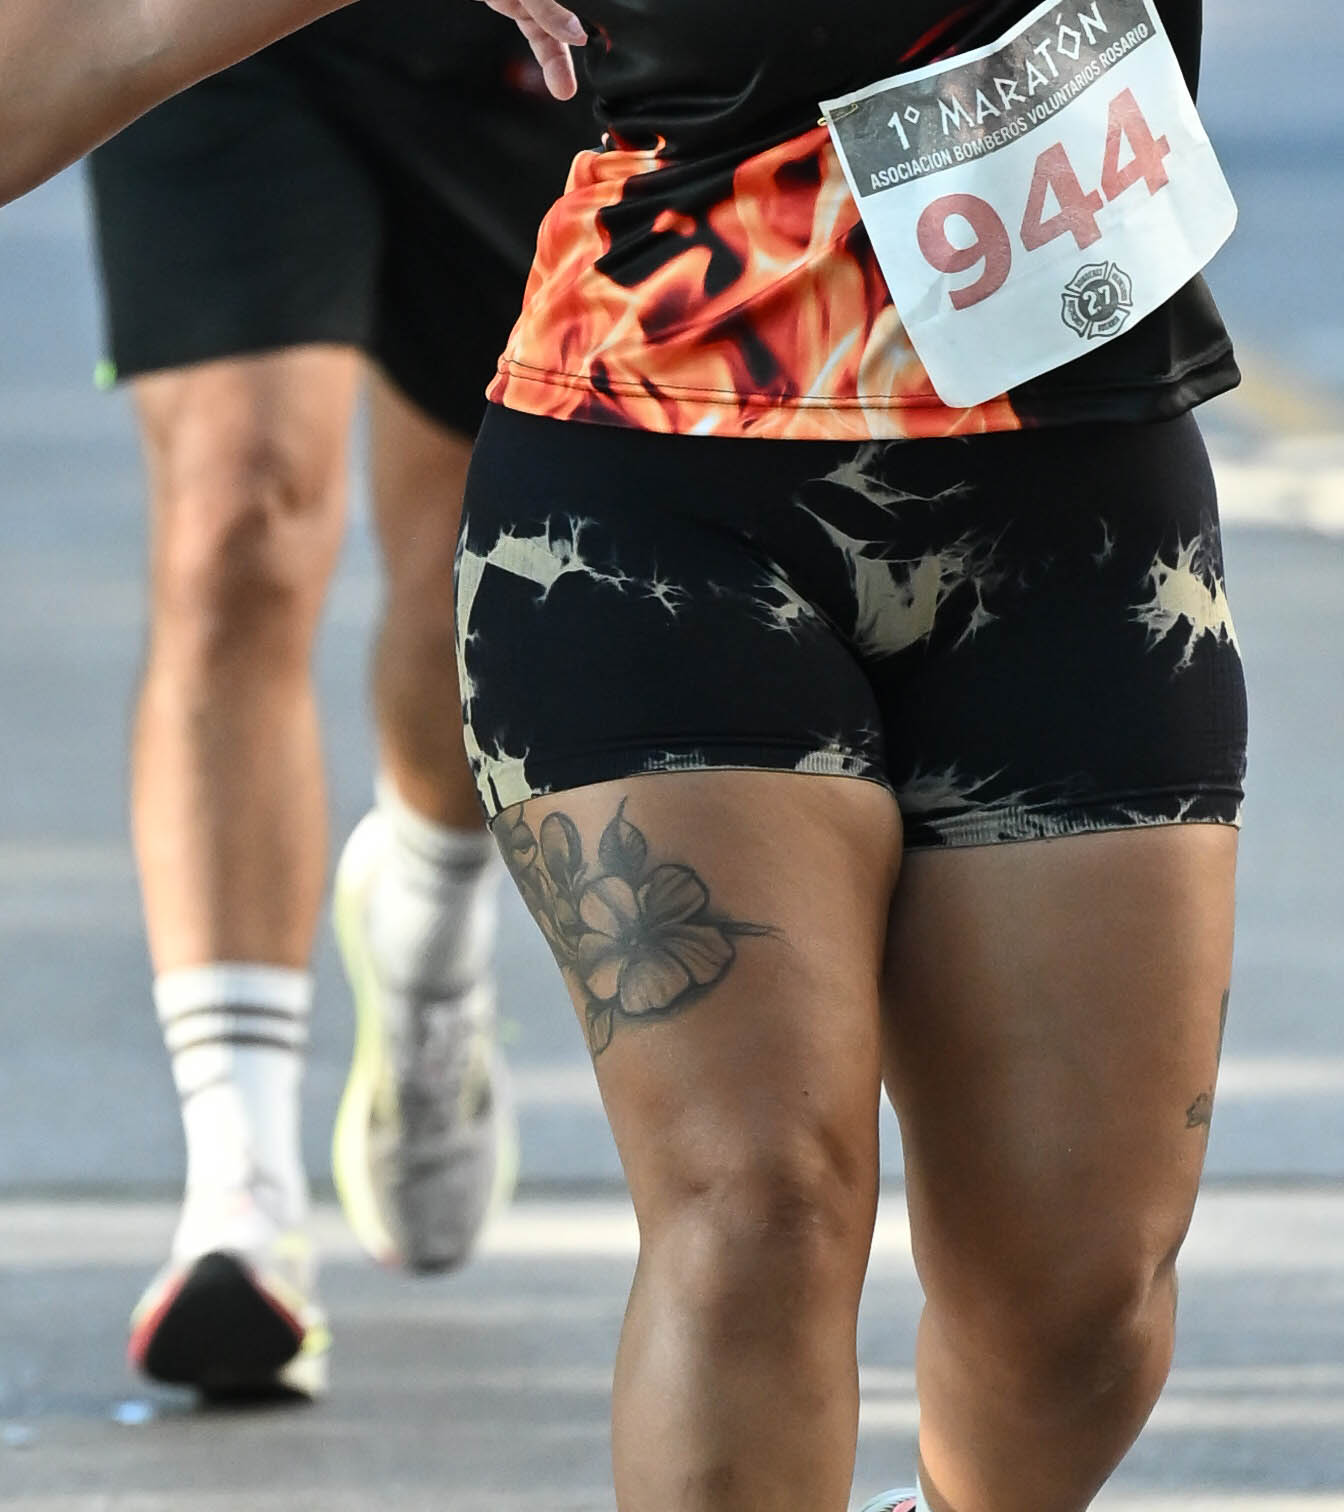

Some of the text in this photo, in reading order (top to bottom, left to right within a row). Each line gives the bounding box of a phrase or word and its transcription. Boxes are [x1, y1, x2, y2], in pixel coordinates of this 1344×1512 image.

[937, 0, 1109, 136] MARATÓN
[953, 117, 1028, 162] BOMBEROS
[1027, 59, 1100, 125] VOLUNTARIOS
[1100, 22, 1149, 69] ROSARIO
[916, 88, 1171, 311] 944
